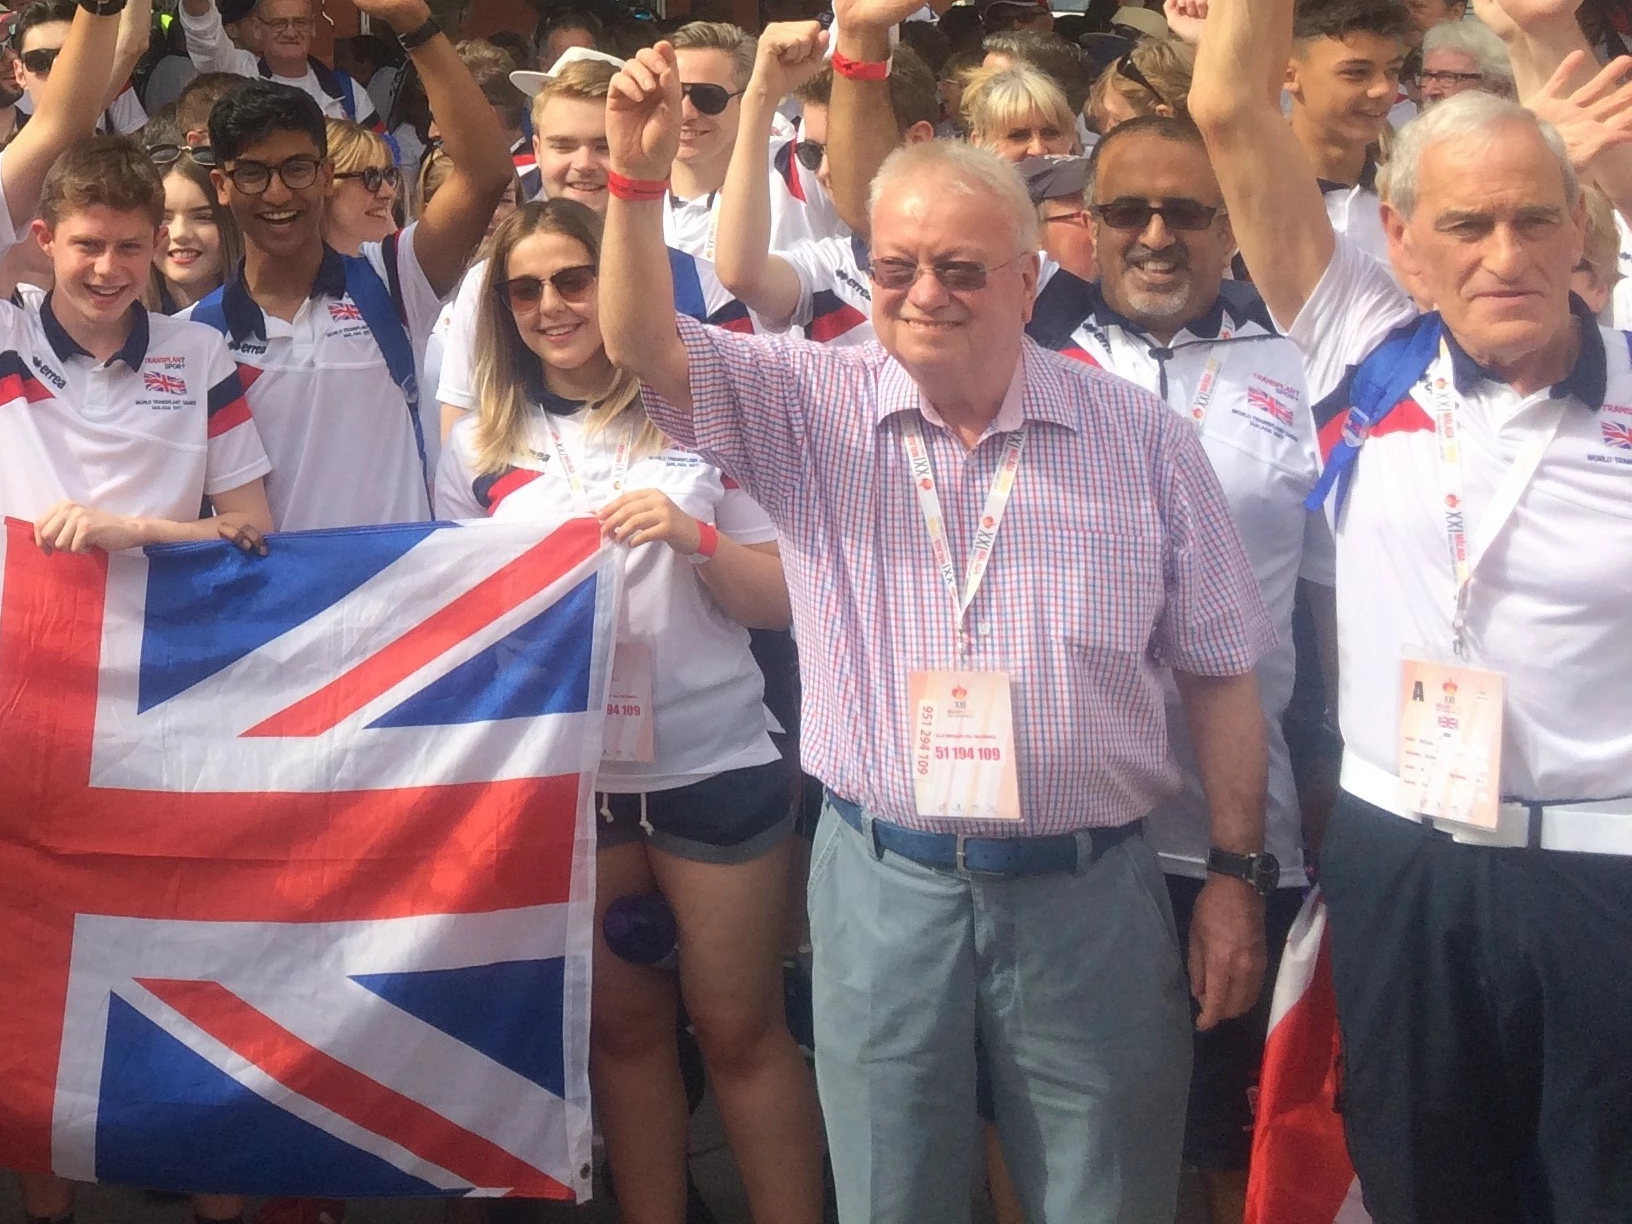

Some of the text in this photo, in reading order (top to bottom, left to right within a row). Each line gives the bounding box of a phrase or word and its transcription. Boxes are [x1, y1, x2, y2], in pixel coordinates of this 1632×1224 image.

[241, 343, 267, 355] errea
[39, 364, 67, 390] errea
[1436, 392, 1452, 412] XXI
[913, 457, 930, 476] XXI
[1445, 511, 1464, 533] XXI
[974, 529, 993, 551] XXI
[941, 563, 954, 585] XXI
[1412, 680, 1425, 702] A
[622, 704, 641, 716] 109
[917, 705, 934, 775] 951 294 109
[935, 746, 1001, 761] 51 194 109
